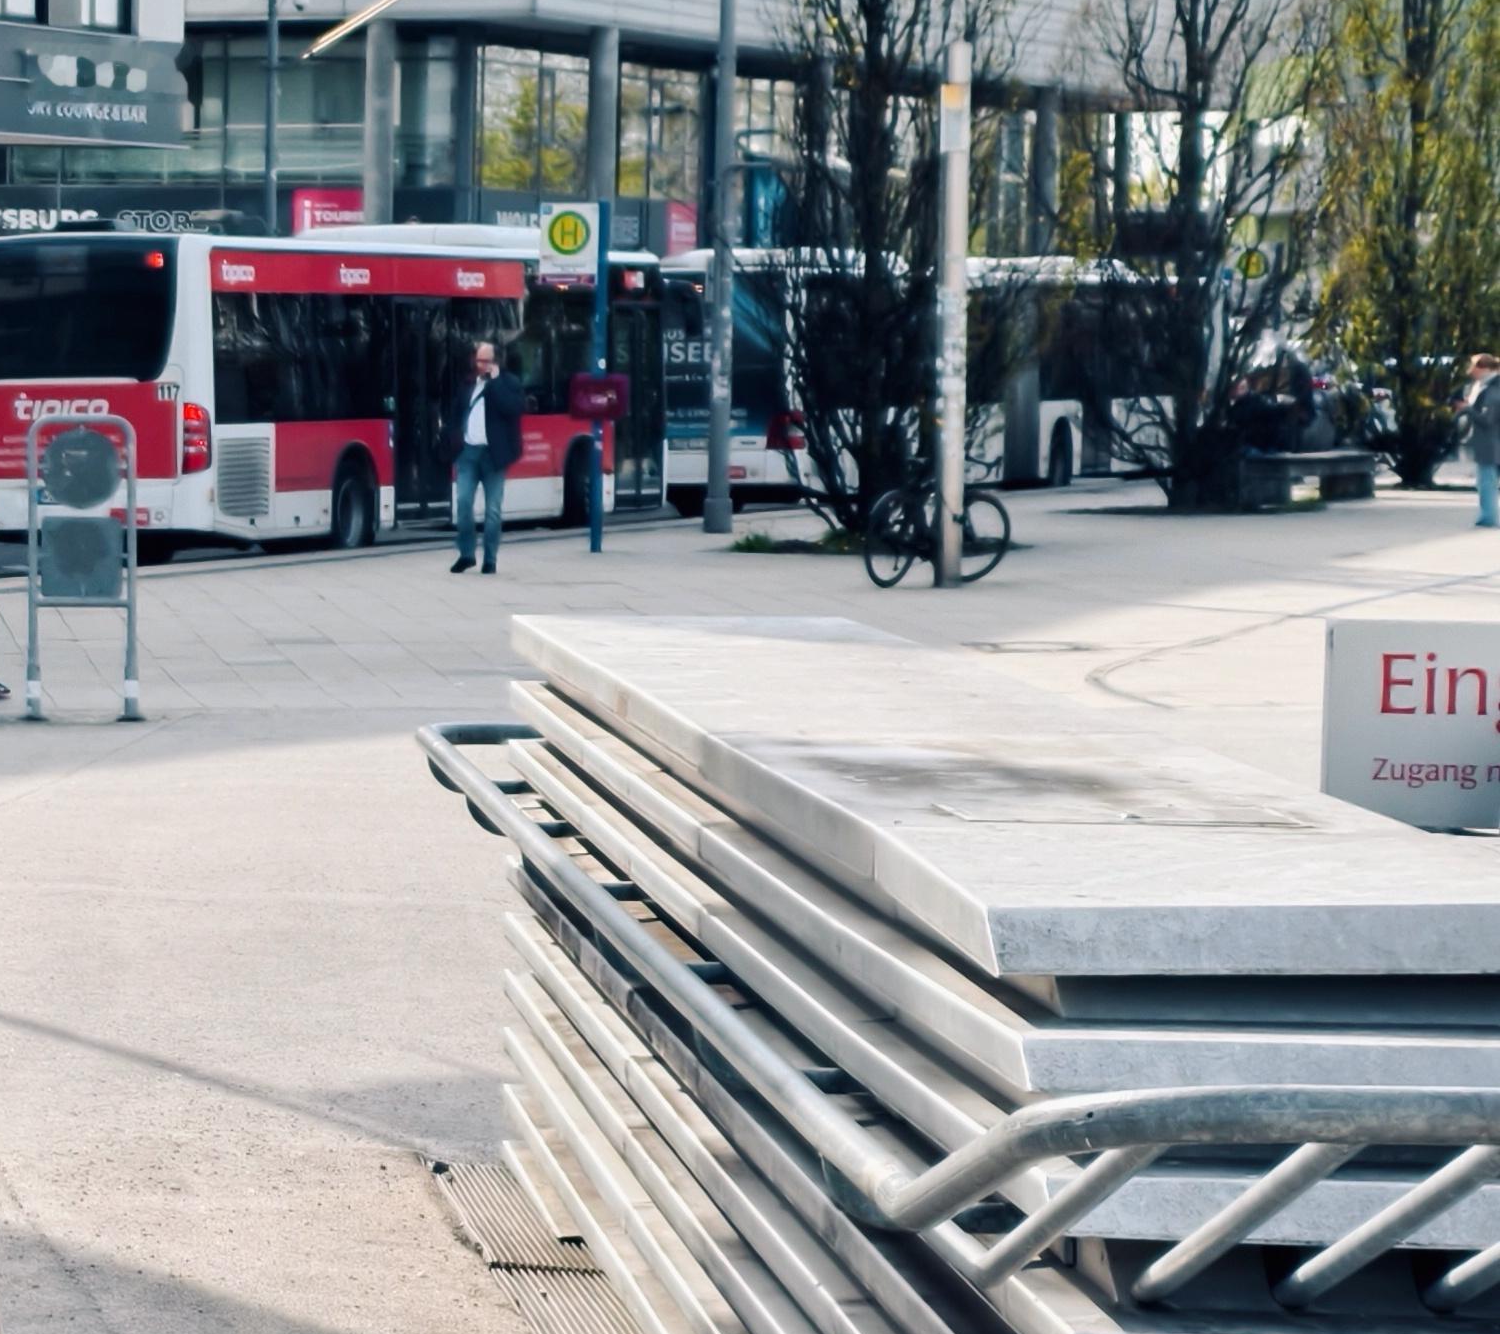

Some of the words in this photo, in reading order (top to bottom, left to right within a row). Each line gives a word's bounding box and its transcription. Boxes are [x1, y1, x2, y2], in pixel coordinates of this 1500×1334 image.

[159, 385, 180, 401] 117
[1380, 652, 1500, 734] Ein
[1372, 758, 1477, 790] Zugang
